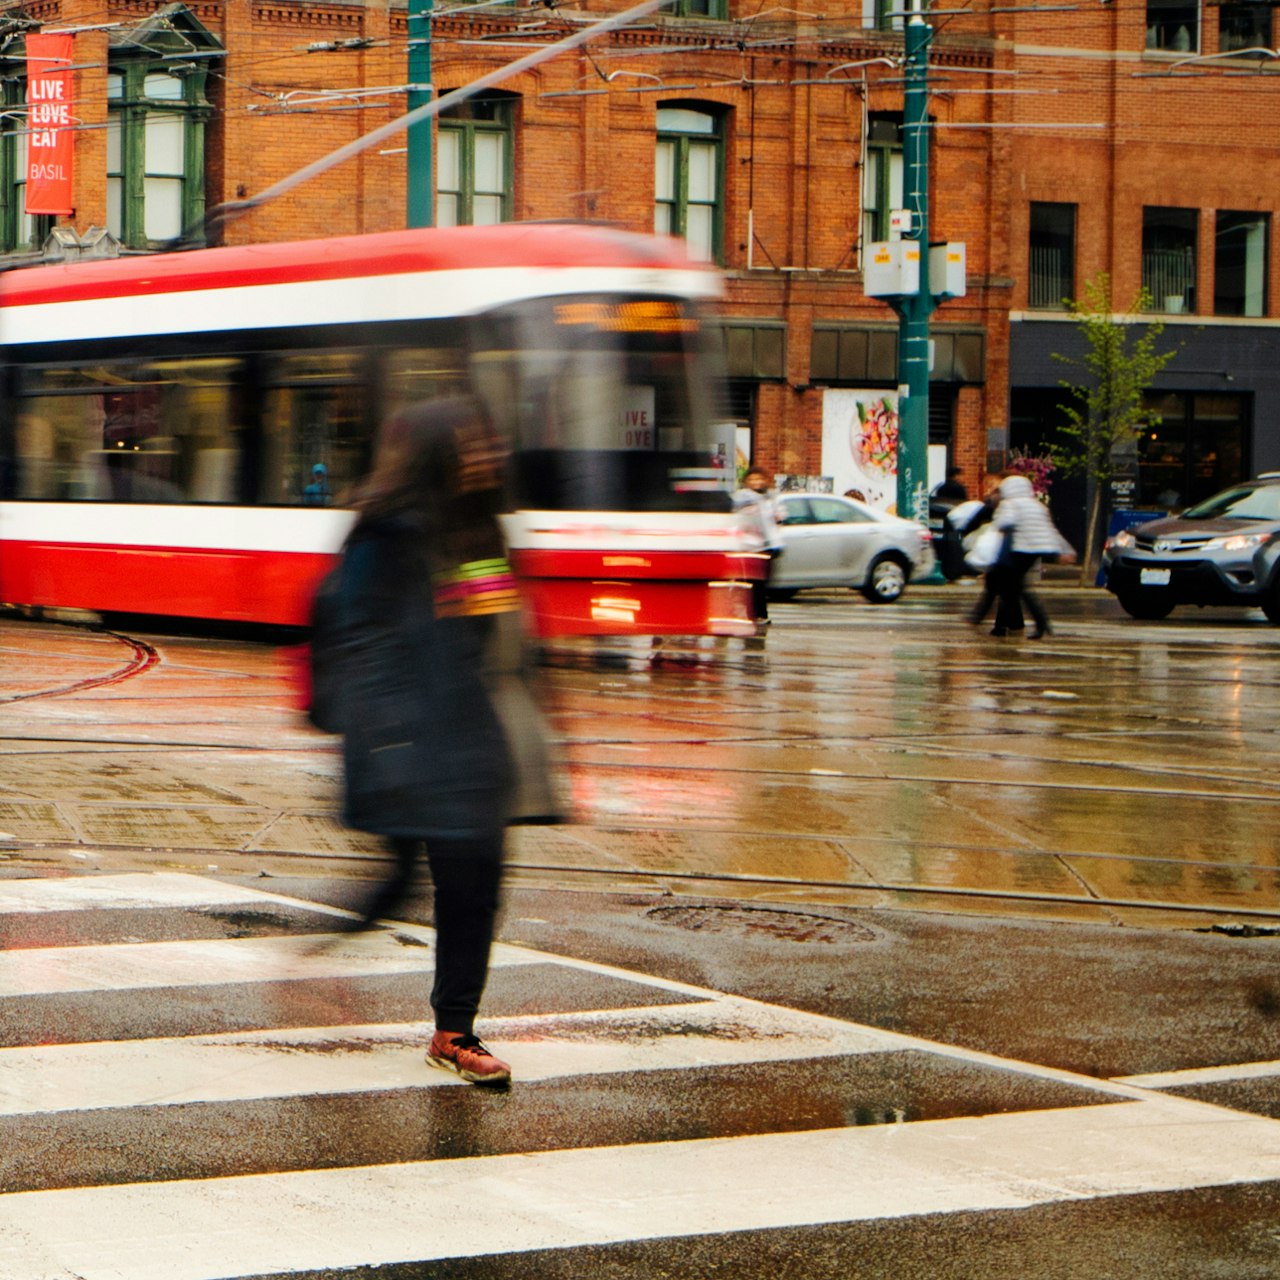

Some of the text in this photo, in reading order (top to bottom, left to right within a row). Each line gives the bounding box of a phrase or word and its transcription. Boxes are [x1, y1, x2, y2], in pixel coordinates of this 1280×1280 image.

[31, 80, 65, 100] LIVE
[32, 103, 69, 125] LOVE
[32, 127, 58, 147] EAT
[31, 164, 67, 180] BASIL
